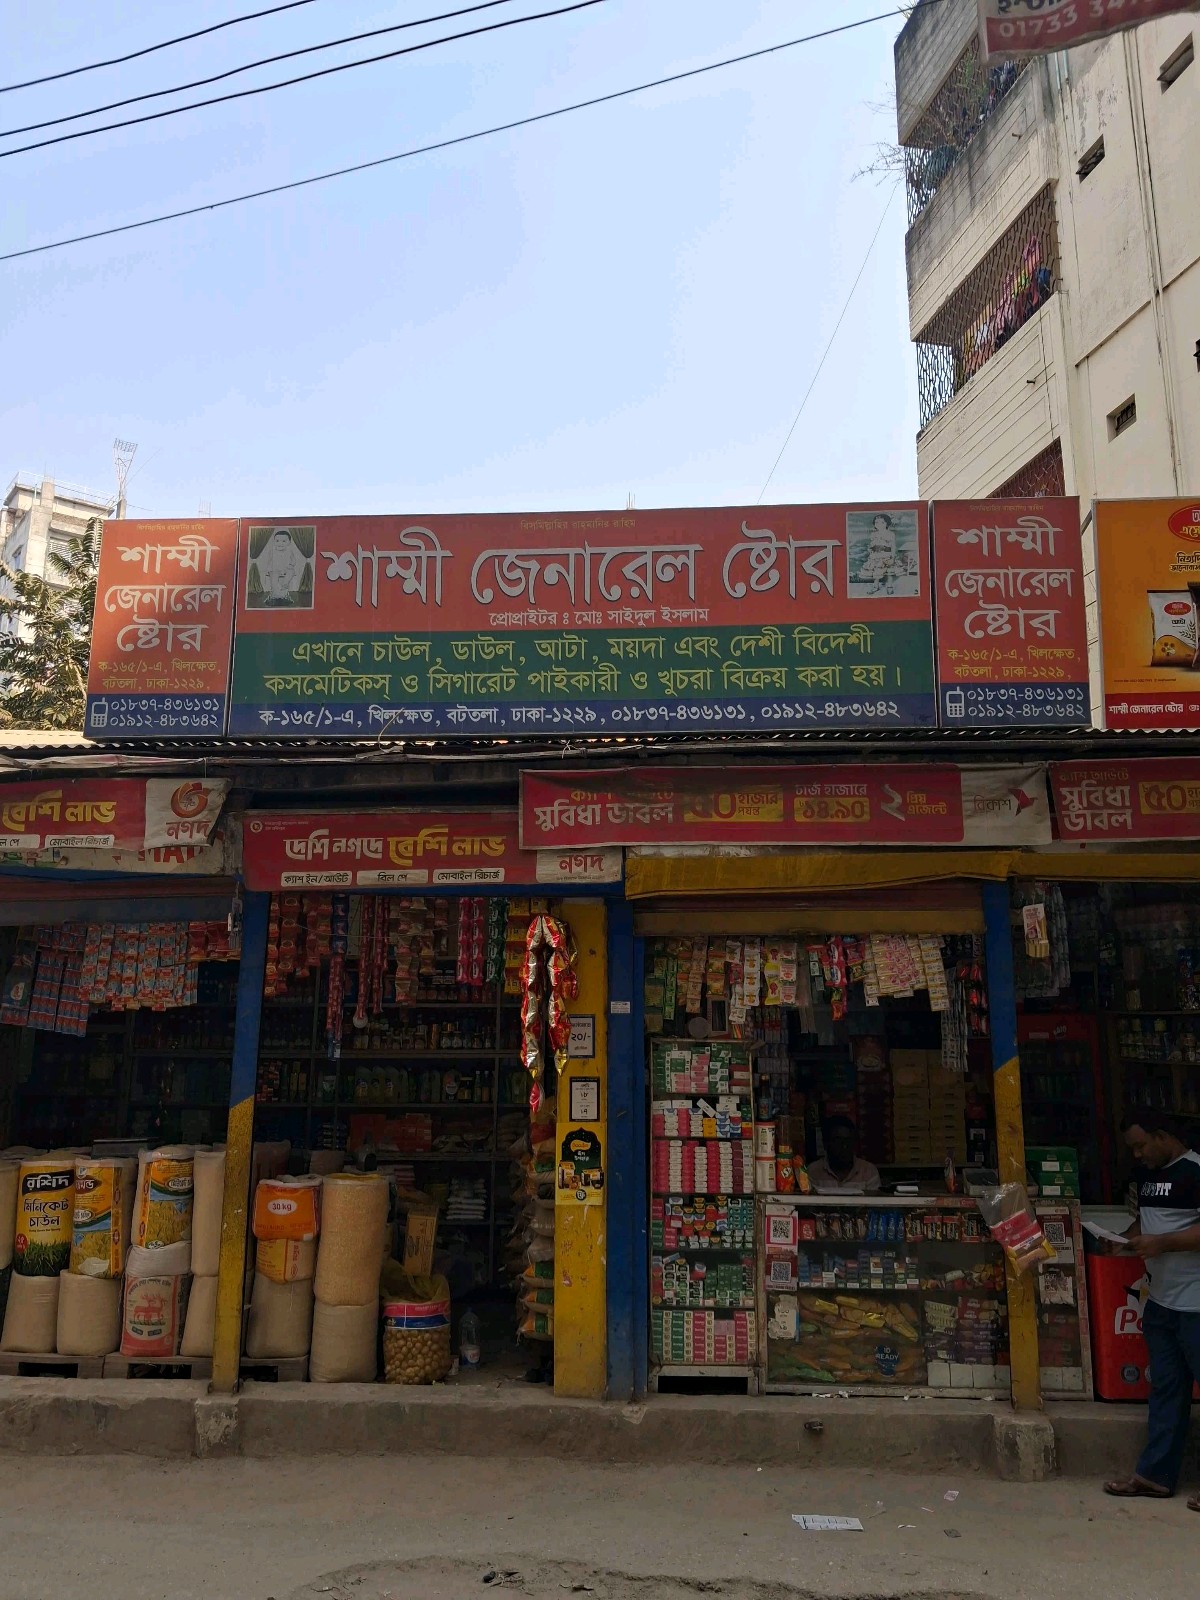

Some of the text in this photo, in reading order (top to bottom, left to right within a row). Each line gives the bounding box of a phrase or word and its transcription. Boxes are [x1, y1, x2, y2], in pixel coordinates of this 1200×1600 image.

[999, 4, 1078, 38] 01733
[950, 515, 1064, 557] শাম্মী
[116, 534, 220, 574] শাম্মী
[319, 520, 843, 608] শাম্মী জেনারেল ষ্টোর
[945, 566, 1076, 599] জেনারেল
[104, 583, 227, 614] জেনারেল
[488, 608, 558, 627] প্রোপ্রাইটর
[574, 610, 603, 626] মোঃ
[607, 607, 656, 628] সাইদুল
[660, 606, 710, 624] ইসলাম
[964, 599, 1062, 640] ষ্টোর
[116, 614, 209, 652] ষ্টোর
[292, 639, 364, 663] এখানে
[607, 636, 666, 660] ময়দা
[674, 634, 721, 659] এবং
[730, 625, 786, 657] দেশী
[792, 623, 875, 655] বিদেশী
[262, 666, 392, 700] কসমেটিকস্
[401, 674, 419, 694] ও
[427, 664, 520, 695] সিগারেট
[527, 662, 622, 695] পাইকারী
[630, 670, 648, 690] ও
[657, 667, 714, 696] খুচরা
[721, 660, 789, 691] বিক্রয়
[794, 663, 843, 688] করা
[850, 664, 887, 687] হয়
[967, 687, 1084, 701] ০১৮৩৭-৪৩৬১৩১
[111, 698, 220, 711] ০১৮৩৭-৪৩৬১৩১
[761, 700, 901, 720] ০১৯১২-৪৮৩৬৪২
[968, 703, 1086, 718] ০১৯১২-৪৮৩৬৪২
[1129, 704, 1164, 714] জেনারেল
[110, 713, 219, 728] ০১৯১২-৪৮৩৬৪২
[738, 791, 778, 805] হাজার
[824, 783, 868, 796] হাজারে
[1059, 779, 1131, 812] সুবিধা
[2, 789, 117, 832] বেশি লাভ
[973, 794, 1011, 813] বিকাশ
[533, 798, 674, 832] সুবিধা ডাবল
[1062, 808, 1133, 832] ডাবল
[165, 820, 211, 840] নগদ
[49, 836, 83, 846] মোবাইল
[283, 824, 507, 867] দেশি নগদে বেশি লাভ
[557, 853, 605, 874] নগদ
[283, 874, 304, 885] ক্যাশ
[377, 871, 395, 883] বিল
[437, 868, 501, 881] মোবাইল রিচার্জ
[26, 1174, 70, 1190] রশিদ
[23, 1198, 69, 1213] মিনিকেট
[281, 1203, 292, 1211] kg
[29, 1214, 60, 1227] চাউল
